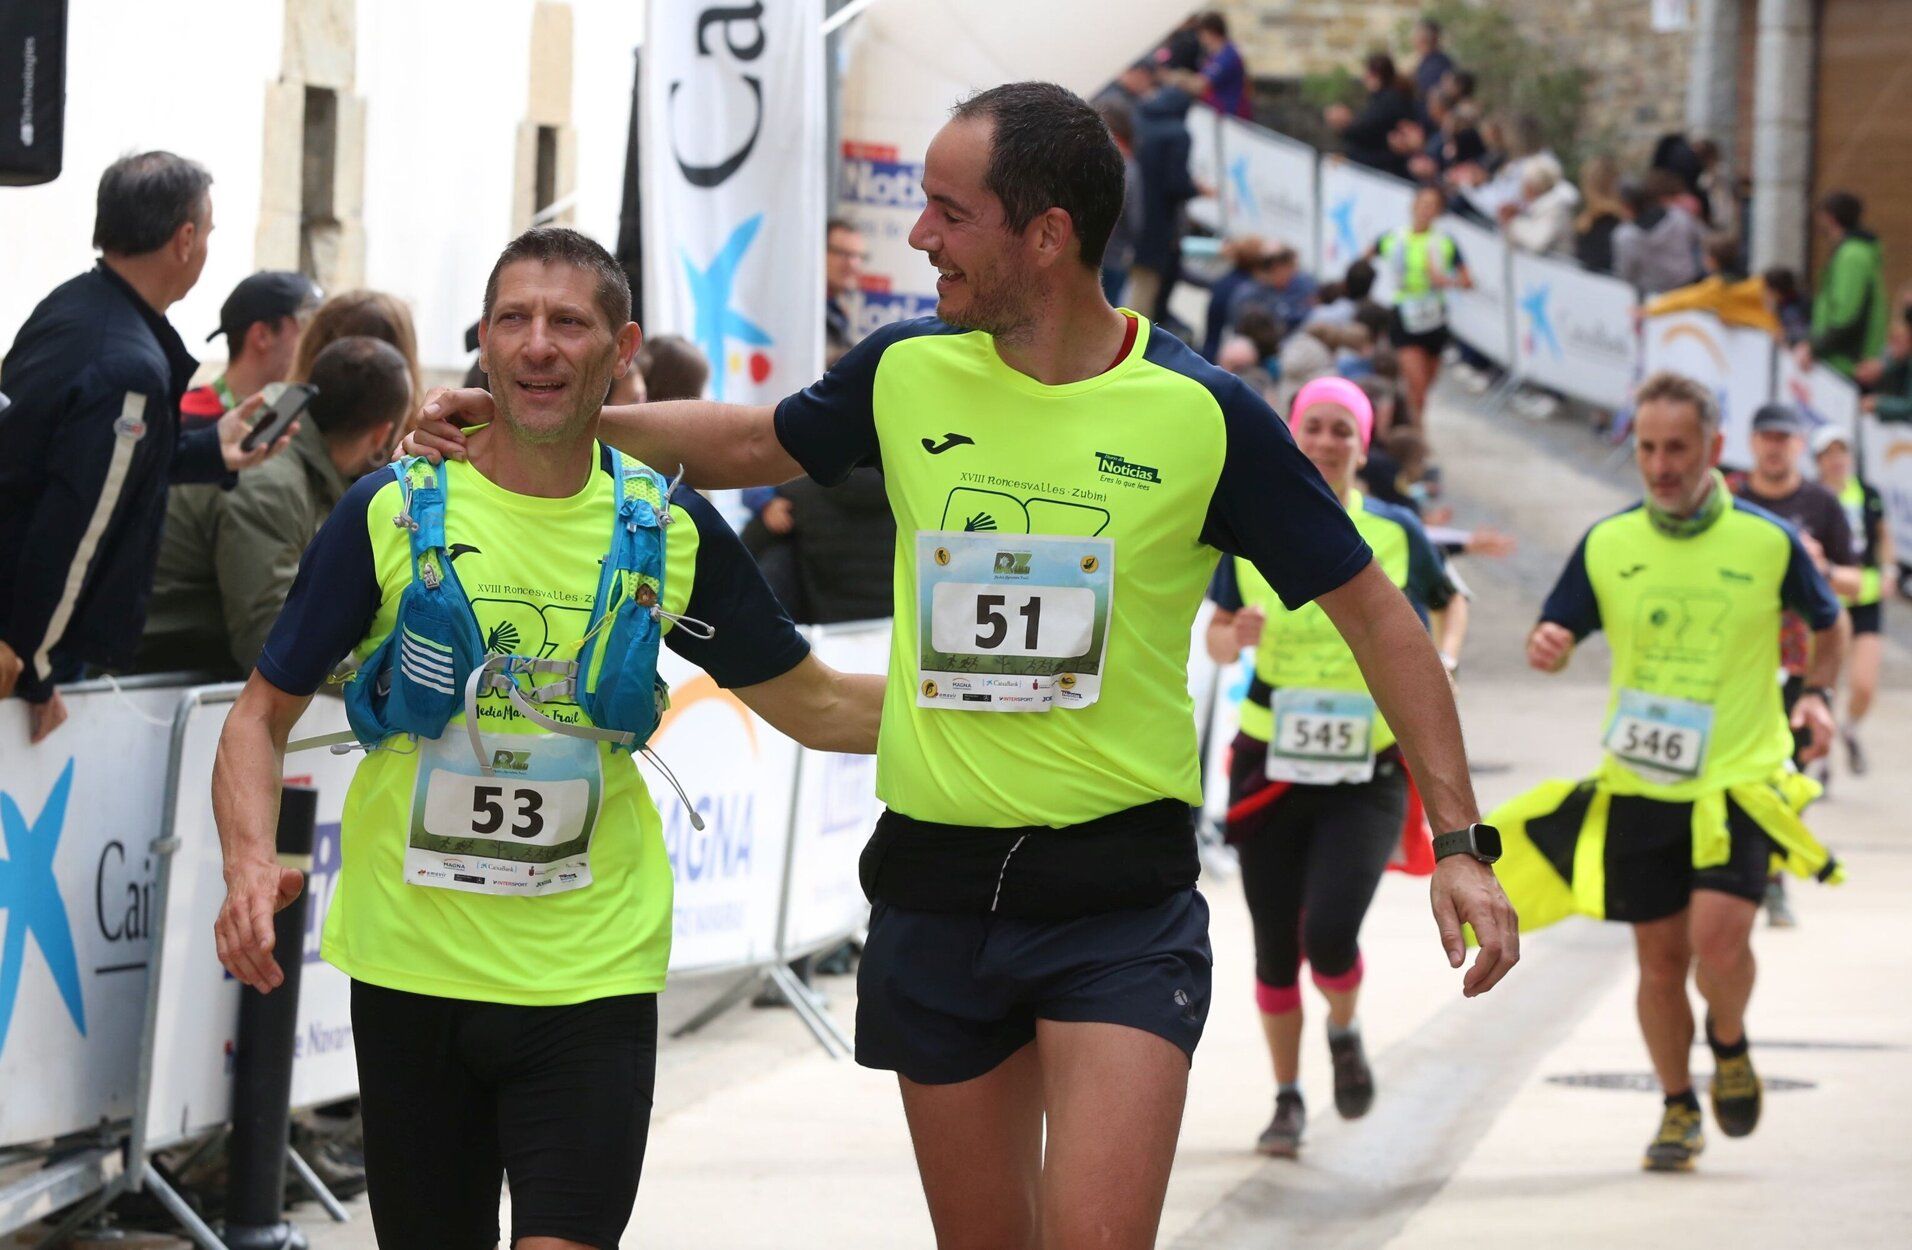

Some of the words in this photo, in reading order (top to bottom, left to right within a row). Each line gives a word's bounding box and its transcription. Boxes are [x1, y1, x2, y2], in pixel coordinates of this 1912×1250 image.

[960, 472, 985, 484] XVIII
[988, 476, 1065, 495] Roncesvalles
[1100, 475, 1114, 484] Eres
[1137, 482, 1150, 491] lees
[1101, 459, 1153, 480] Noticias
[478, 584, 501, 593] XVIII
[504, 586, 578, 601] Roncesvalles
[975, 594, 1041, 649] 51
[553, 709, 580, 724] Trail
[1296, 720, 1352, 749] 545
[1625, 725, 1683, 760] 546
[472, 786, 544, 838] 53
[657, 793, 755, 882] AGNA
[97, 840, 150, 941] Cai
